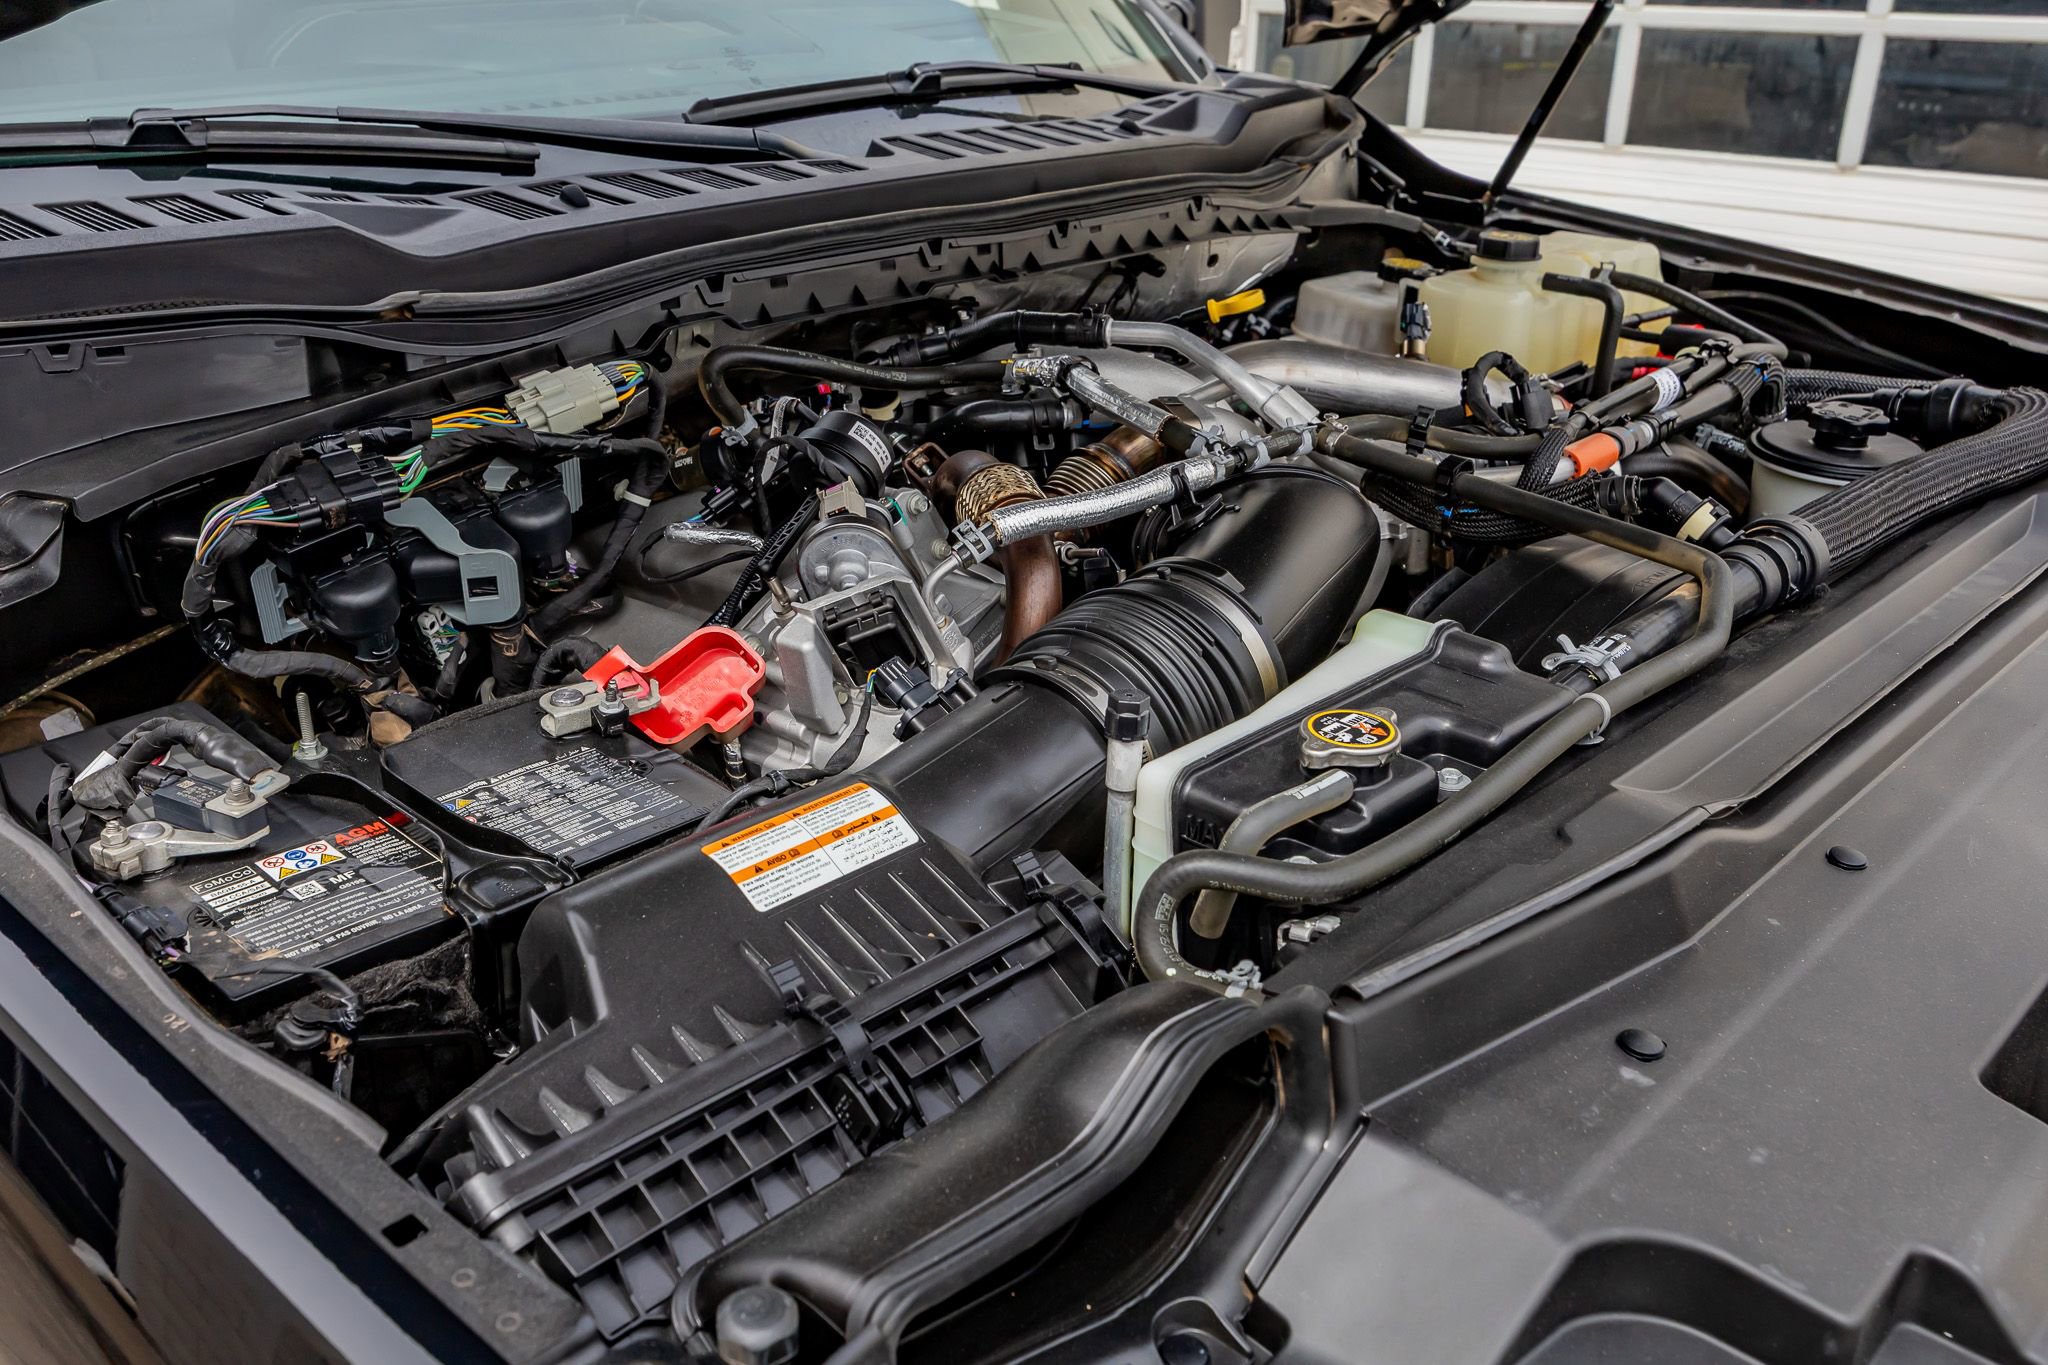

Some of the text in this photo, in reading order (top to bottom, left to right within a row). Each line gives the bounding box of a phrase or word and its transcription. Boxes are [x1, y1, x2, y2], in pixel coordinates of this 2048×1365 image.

[335, 822, 385, 843] AGM
[767, 854, 787, 866] AVISO
[194, 869, 251, 893] FoMoCo
[329, 870, 355, 884] MF
[284, 949, 300, 958] NOT
[300, 942, 323, 953] OPEN.
[335, 930, 351, 939] PAS
